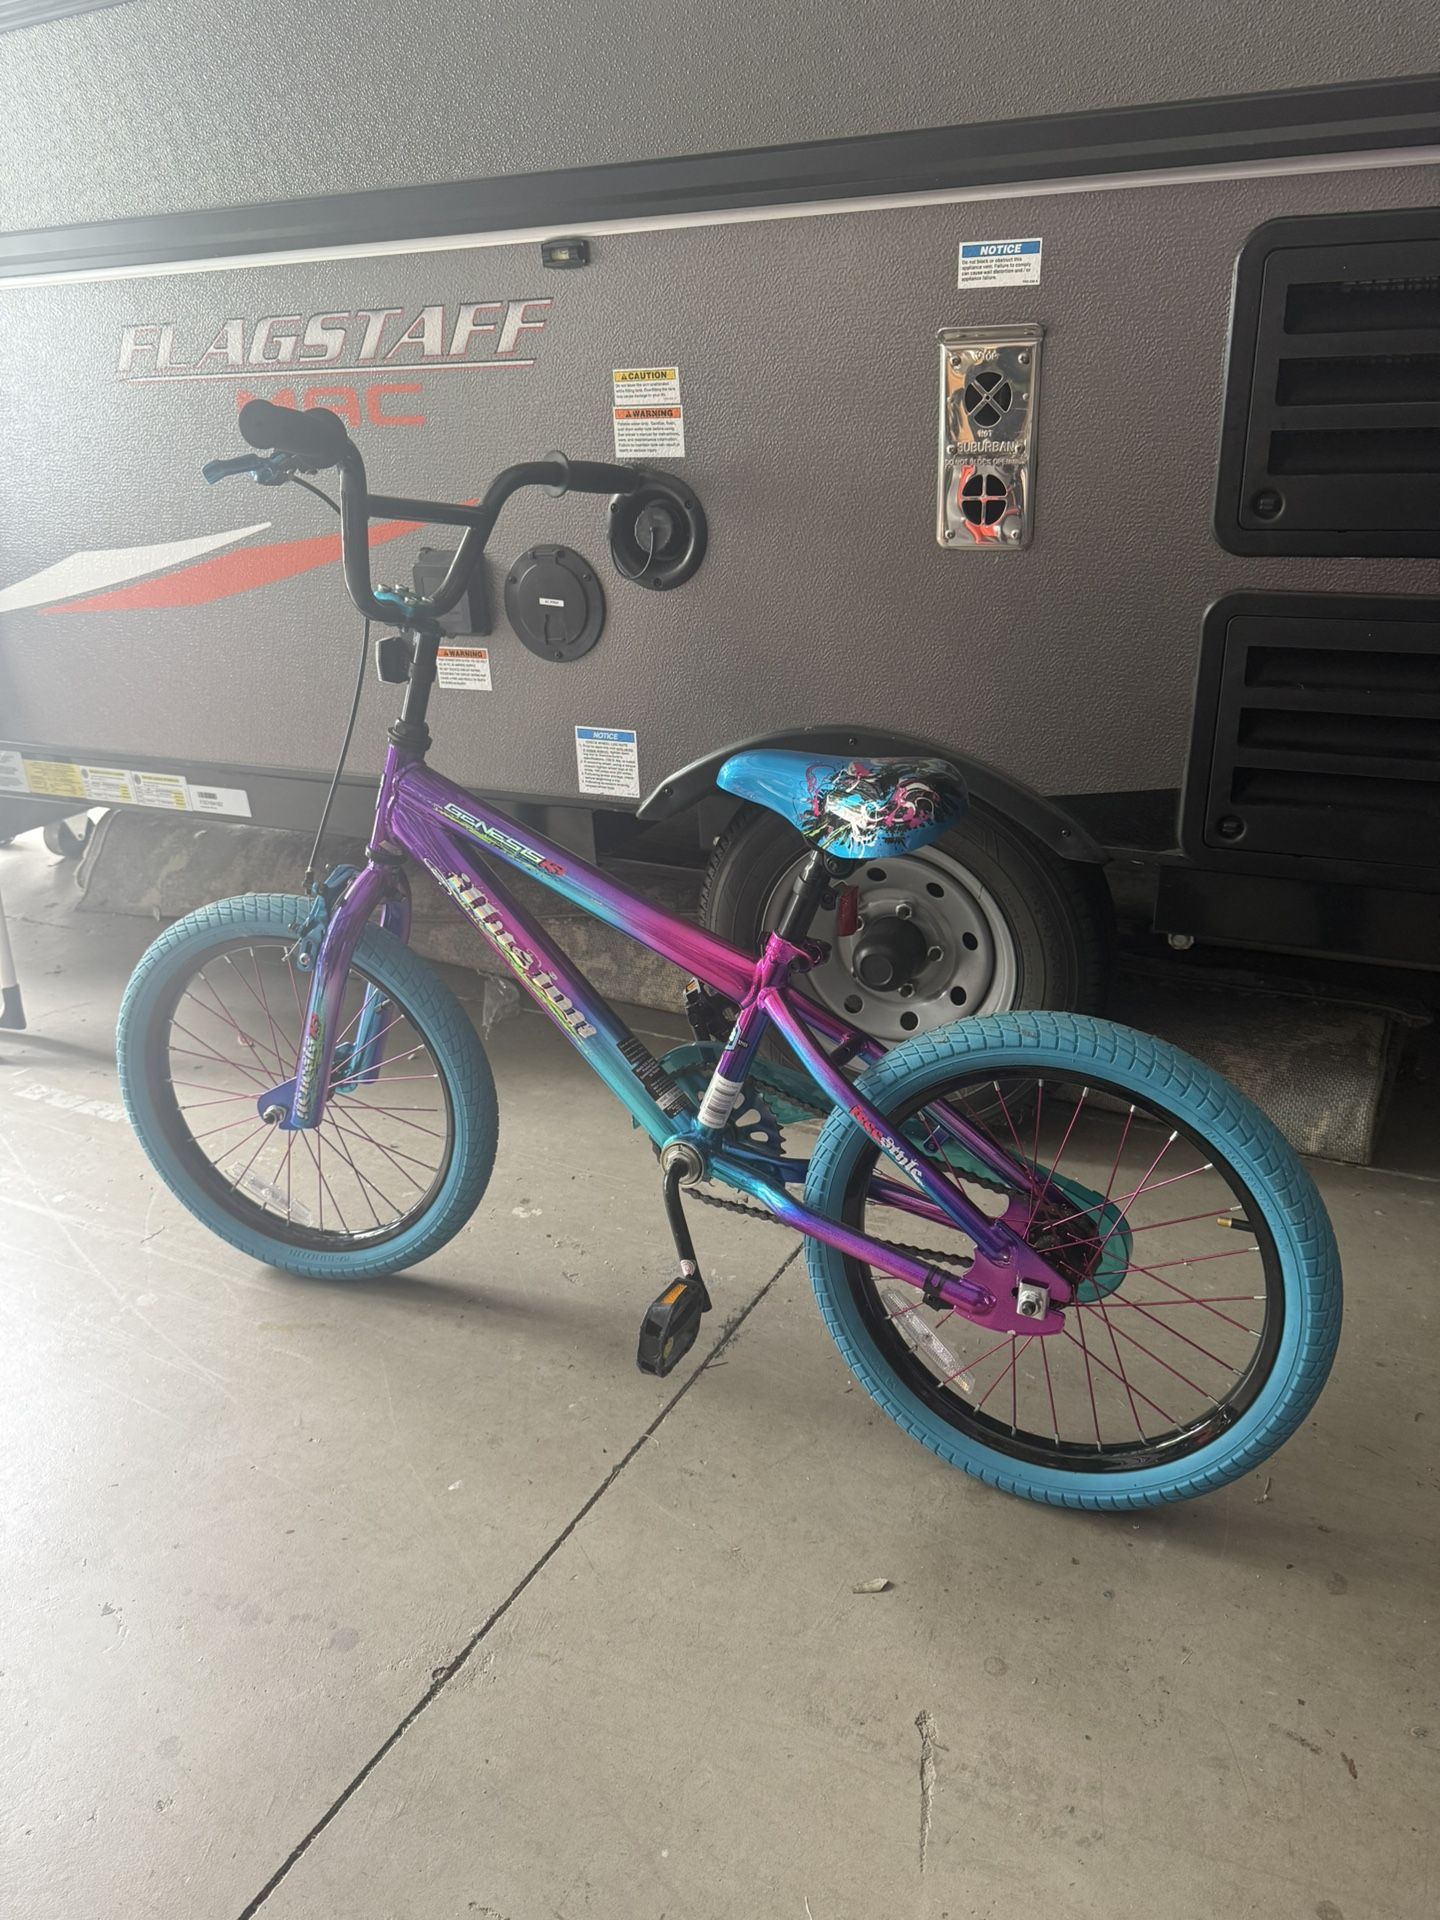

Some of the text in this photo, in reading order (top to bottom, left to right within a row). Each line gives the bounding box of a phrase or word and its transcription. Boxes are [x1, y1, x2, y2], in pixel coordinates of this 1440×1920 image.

[980, 243, 1022, 255] NOTICE
[117, 297, 554, 371] FLAGSTAFF
[628, 371, 667, 380] CAUTION
[633, 409, 673, 418] WARNING
[957, 440, 1015, 453] SUBURBAN
[450, 650, 483, 658] WARNING
[592, 731, 619, 740] NOTICE
